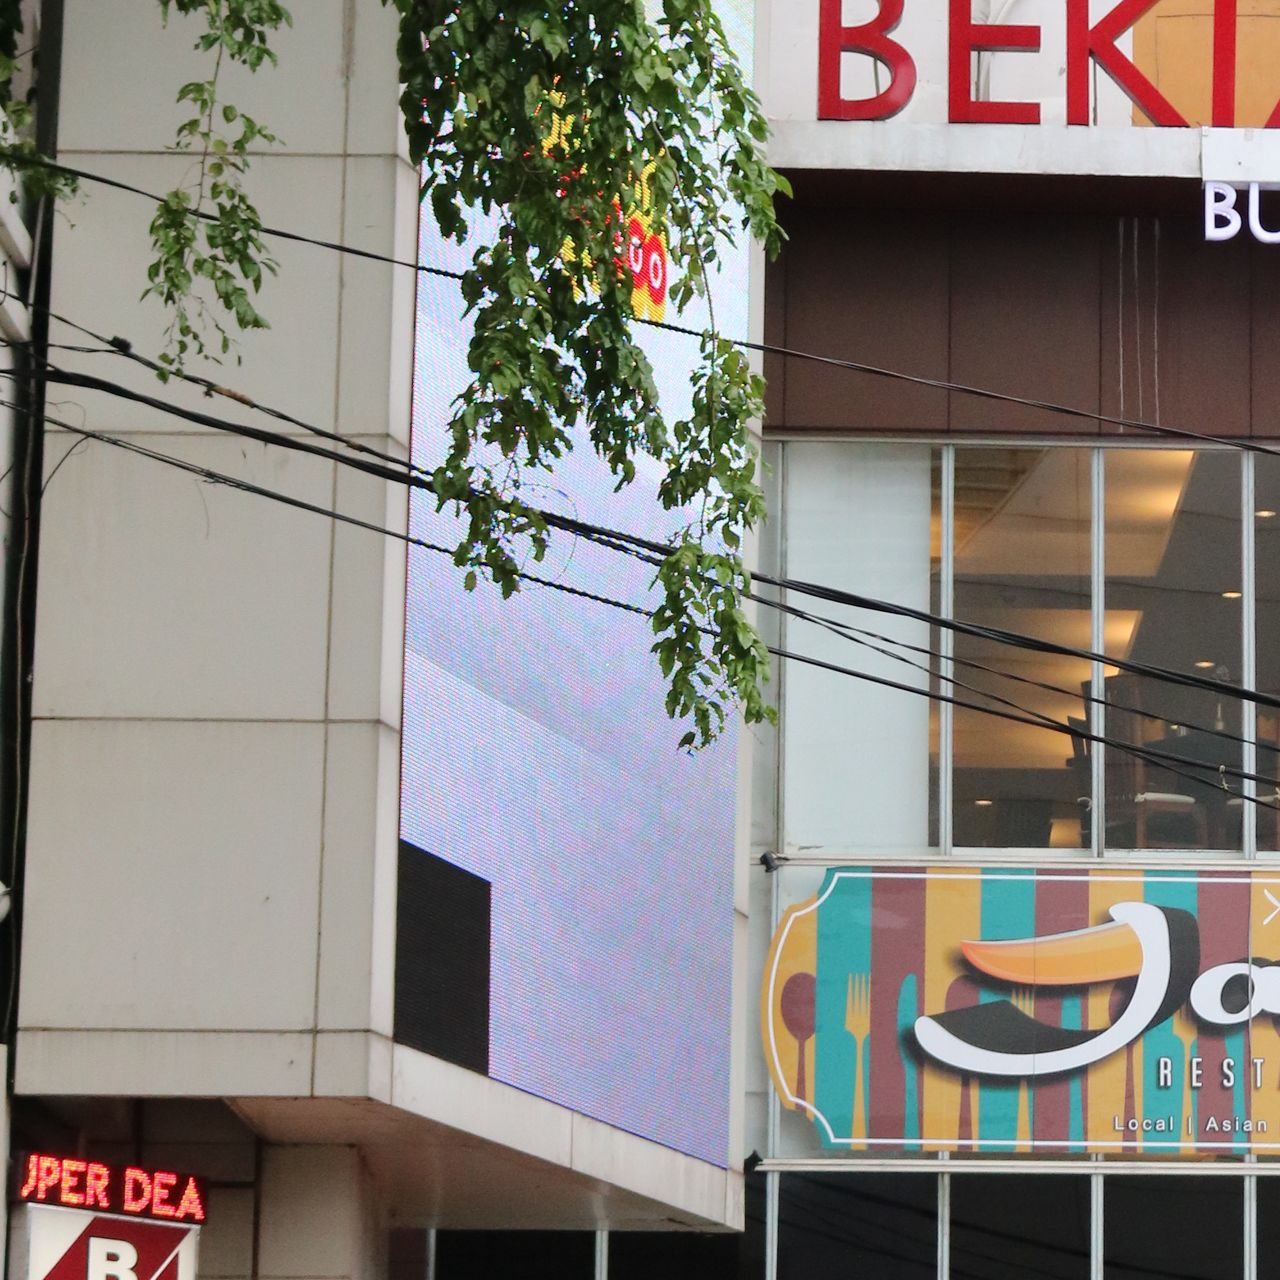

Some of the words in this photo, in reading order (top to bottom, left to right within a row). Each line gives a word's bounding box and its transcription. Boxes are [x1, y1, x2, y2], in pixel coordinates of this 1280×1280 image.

[1112, 1114, 1176, 1135] Local
[1205, 1116, 1269, 1136] Asian
[123, 1167, 205, 1220] DEA
